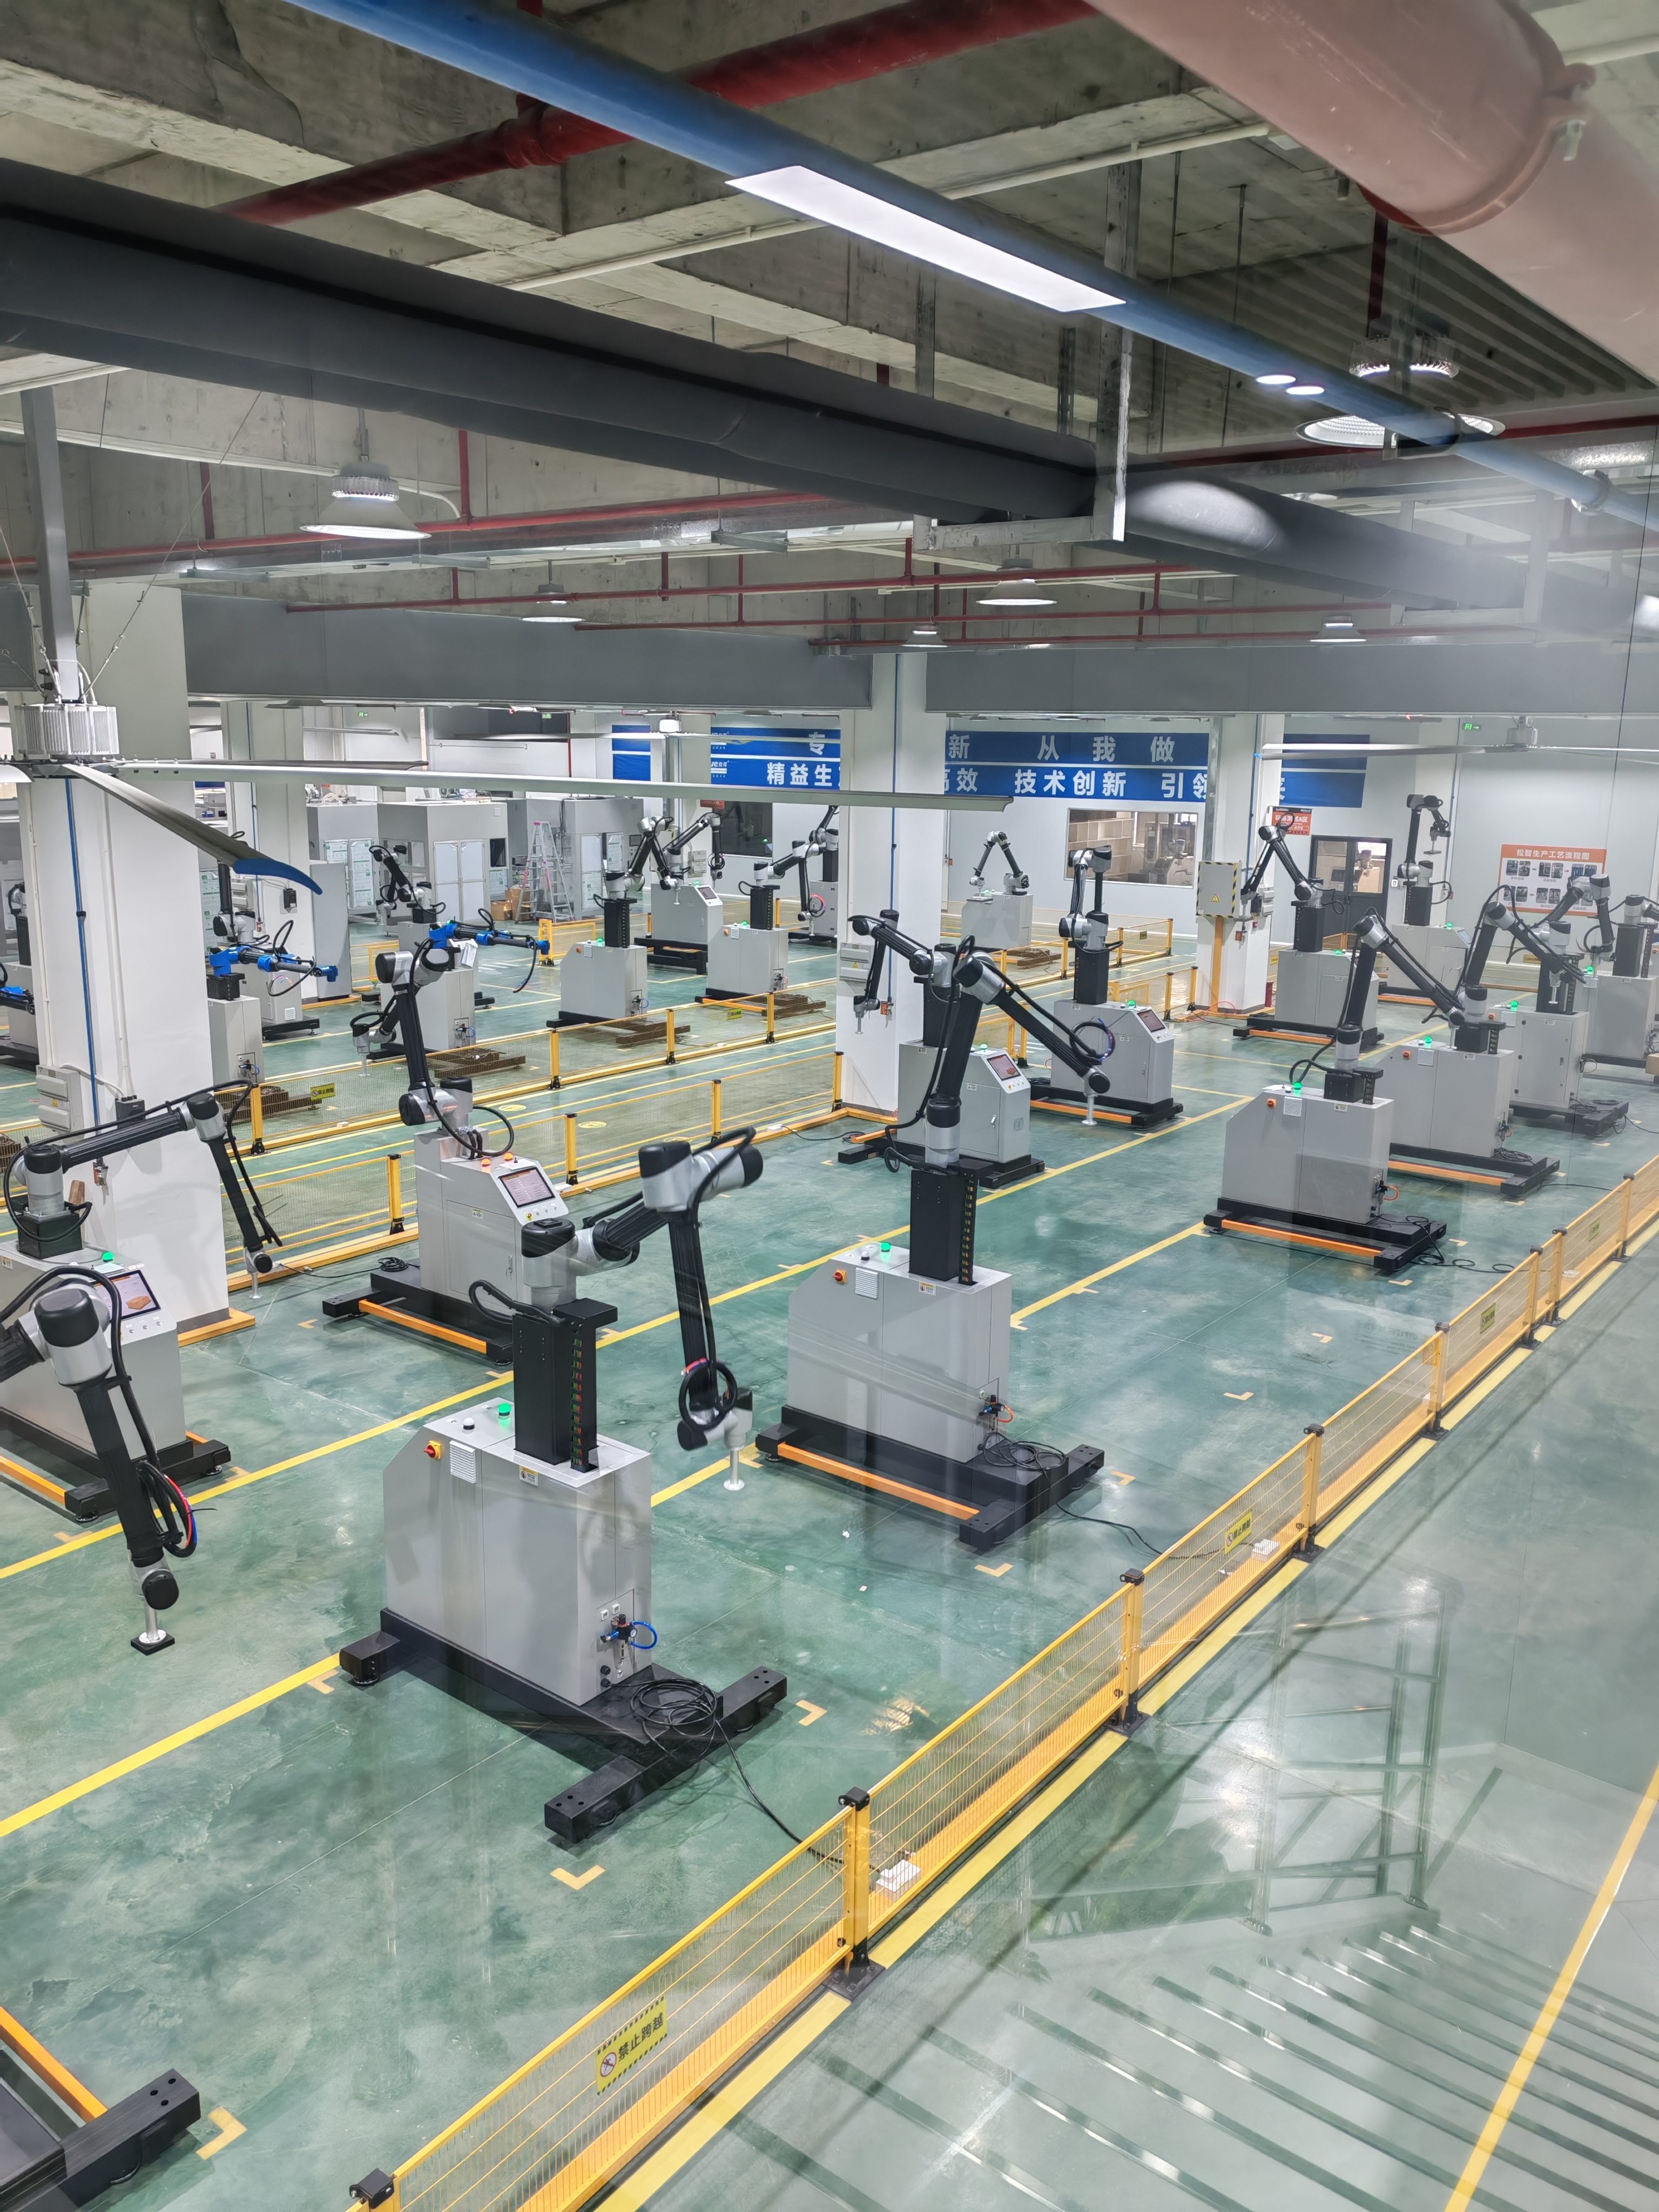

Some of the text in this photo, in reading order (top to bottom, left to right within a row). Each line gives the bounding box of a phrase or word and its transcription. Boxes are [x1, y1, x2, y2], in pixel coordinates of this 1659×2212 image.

[948, 734, 970, 759] 新
[767, 761, 840, 787] 精益生
[944, 767, 978, 793] 效
[1014, 768, 1126, 797] 技术创新
[618, 2012, 663, 2062] 禁止跨越
